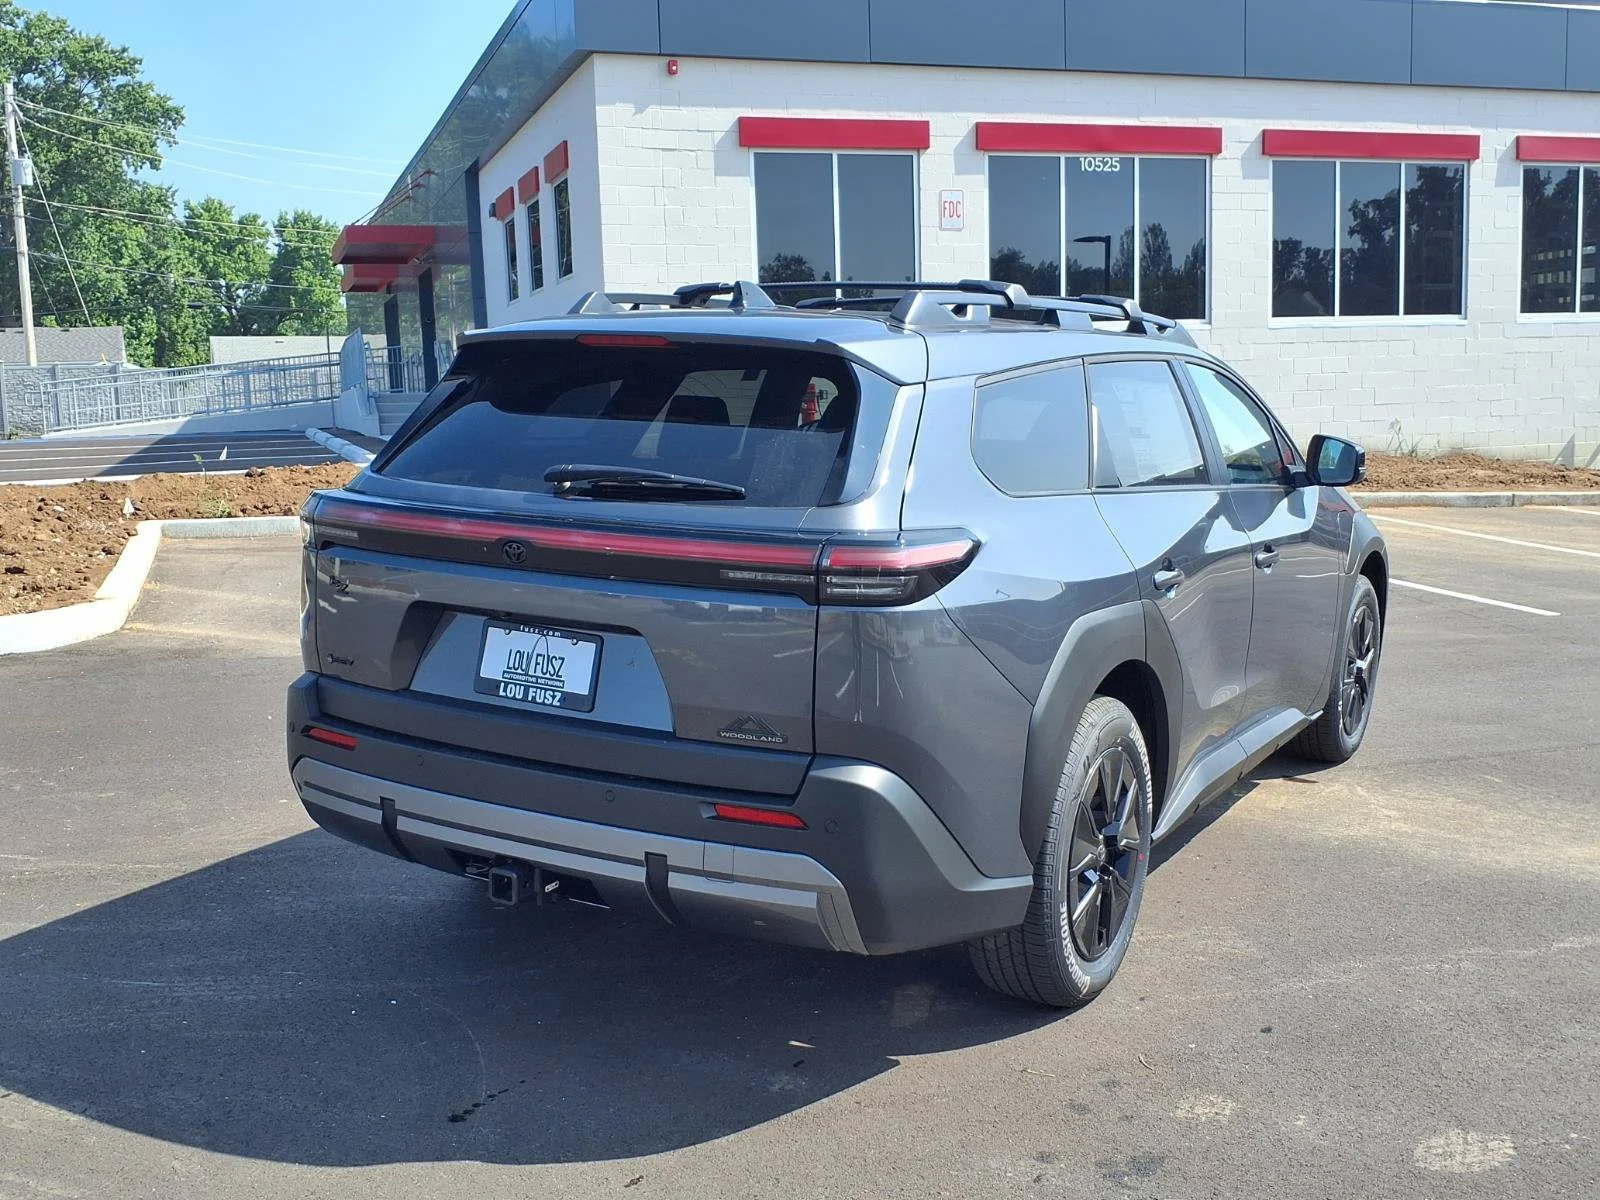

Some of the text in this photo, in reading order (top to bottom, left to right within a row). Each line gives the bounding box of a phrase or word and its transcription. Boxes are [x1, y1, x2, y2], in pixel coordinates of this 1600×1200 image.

[1079, 157, 1120, 172] 10525
[943, 201, 962, 218] FDC
[520, 625, 561, 637] fusz.com
[507, 649, 565, 678] LOU FUSZ
[503, 673, 564, 688] AUTOMOTIVE NETWORK
[499, 682, 562, 706] LOU FUSZ
[720, 731, 783, 743] WOODLAND
[1060, 901, 1091, 997] BRIDGESTONE
